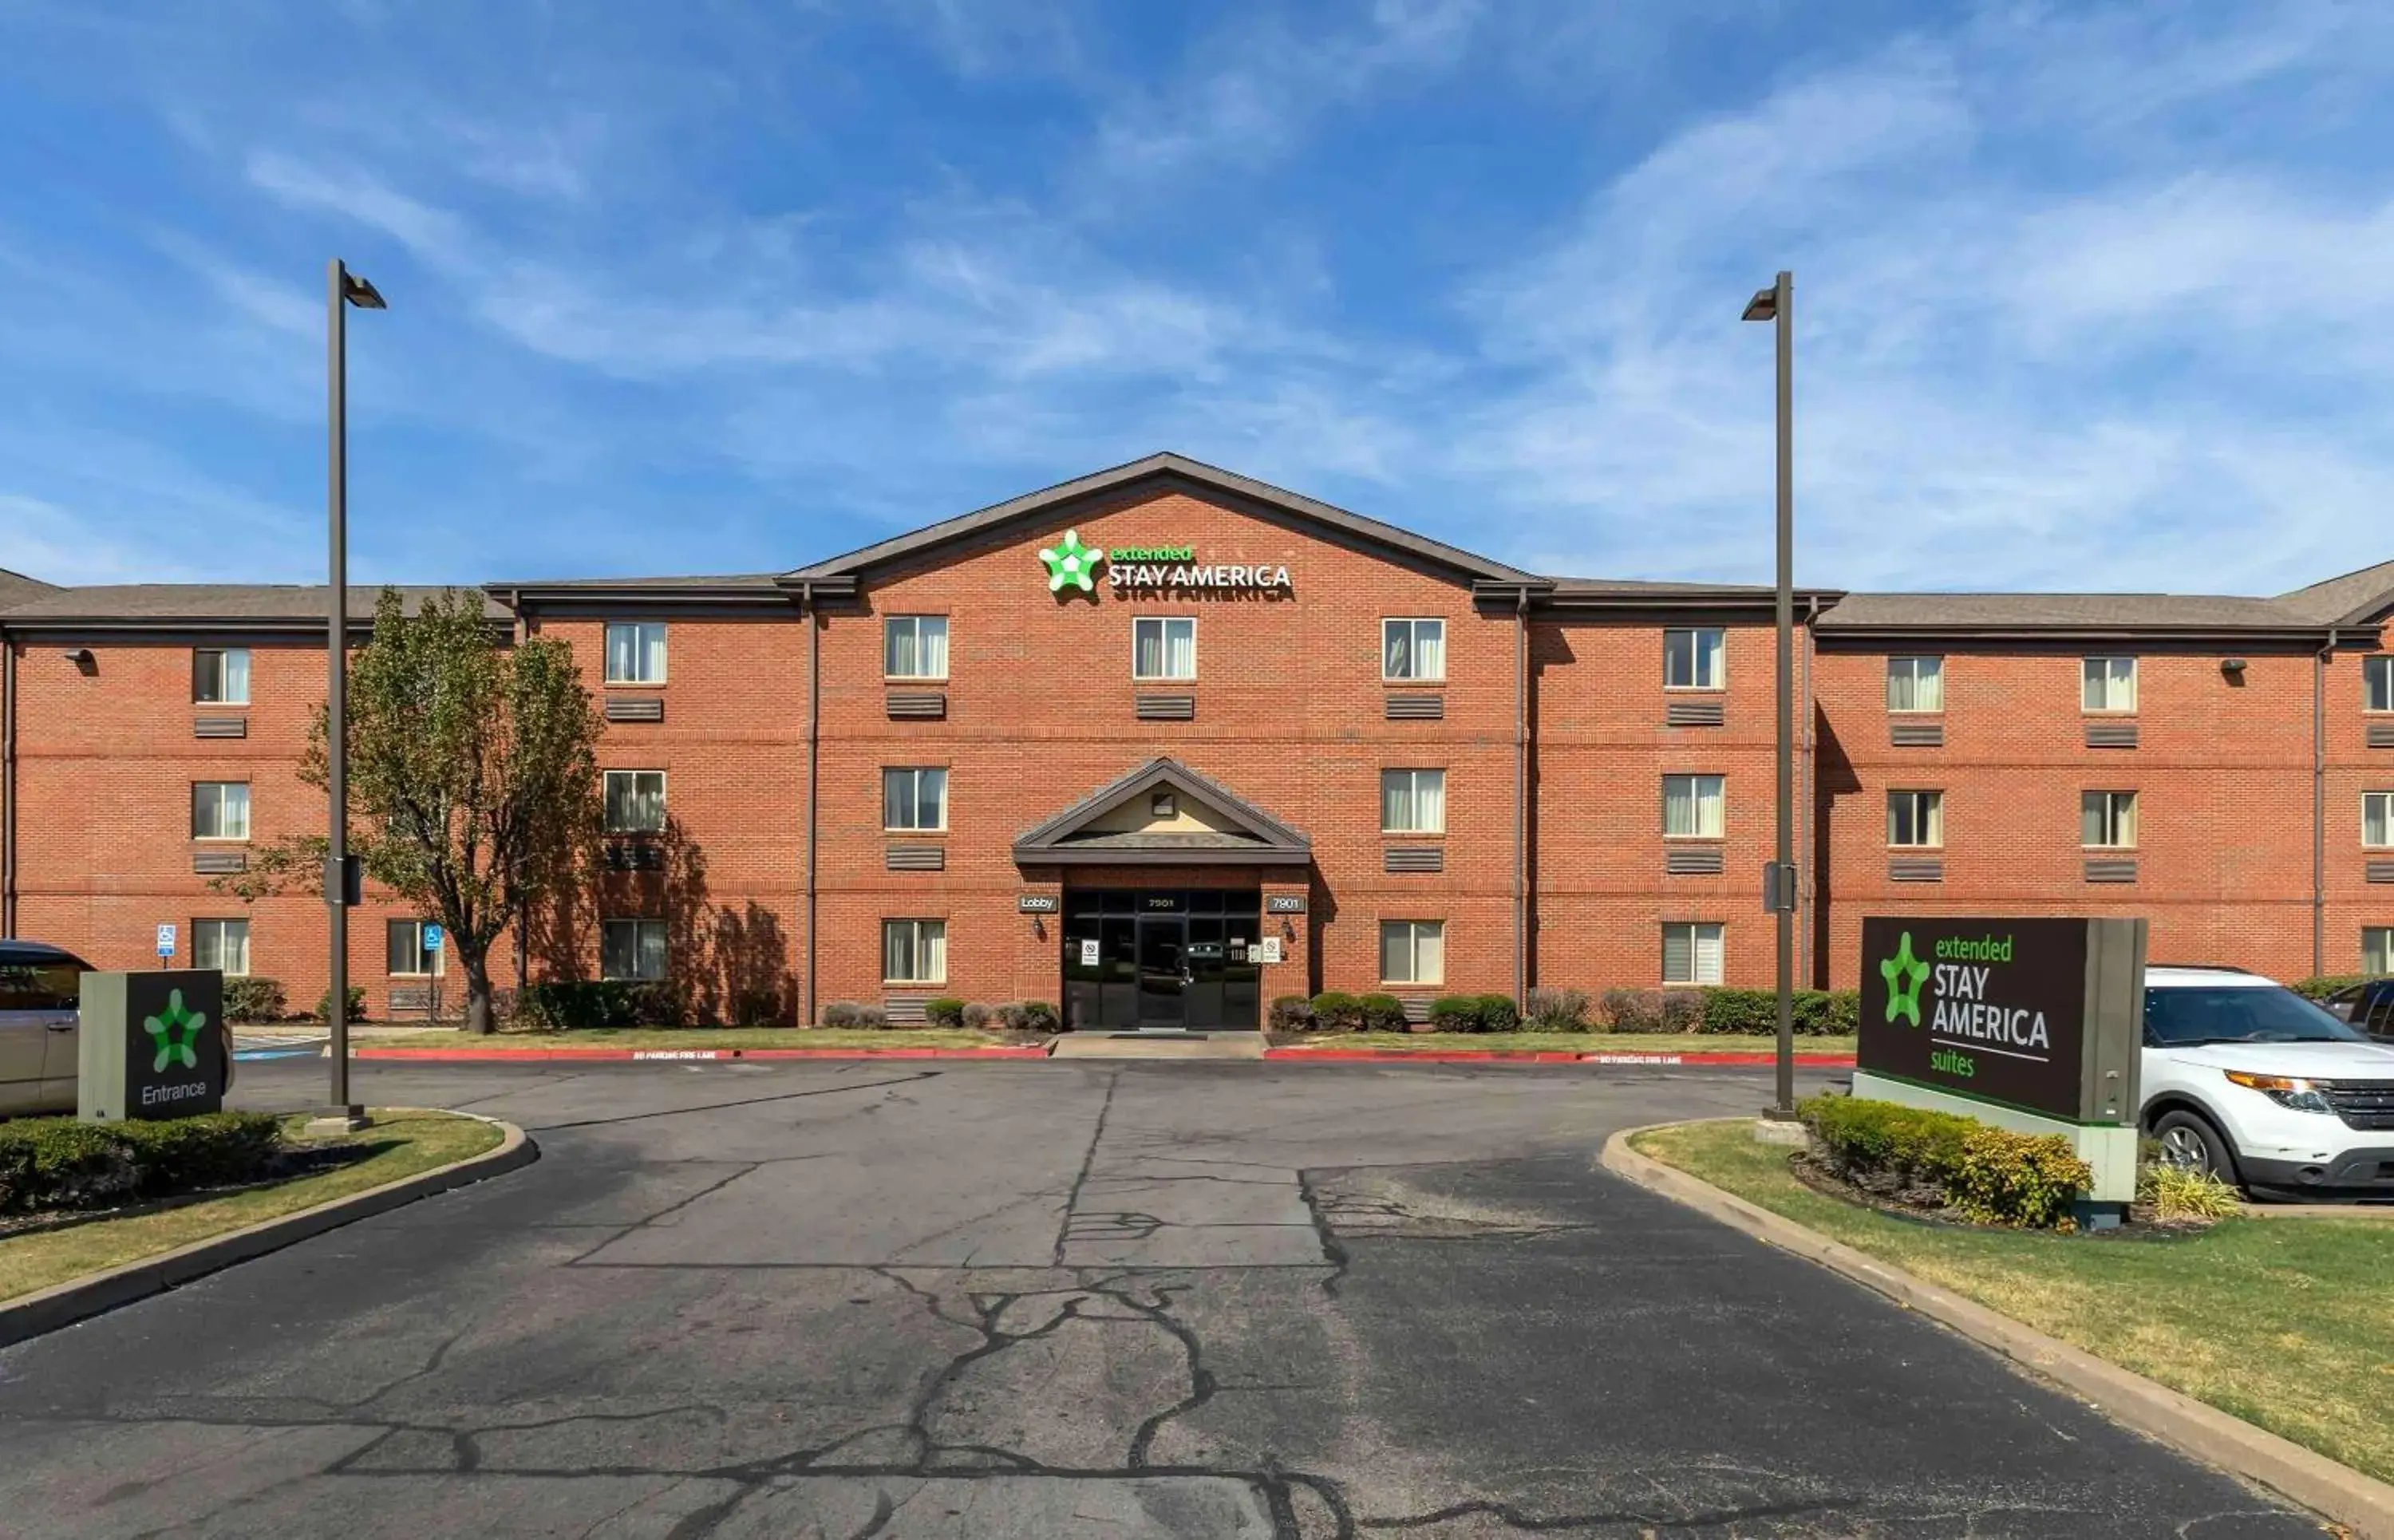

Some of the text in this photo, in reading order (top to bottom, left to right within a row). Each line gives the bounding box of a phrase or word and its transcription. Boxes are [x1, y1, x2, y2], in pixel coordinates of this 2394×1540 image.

[1111, 547, 1191, 561] extended
[1108, 563, 1291, 587] STAY AMERICA
[1021, 897, 1053, 909] Lobby
[1273, 898, 1298, 909] 7901
[1935, 934, 2012, 962] extended
[1934, 963, 1990, 1001] STAY
[1931, 1000, 2050, 1049] AMERICA
[1930, 1049, 1974, 1078] suites
[143, 1082, 206, 1104] Entrance
